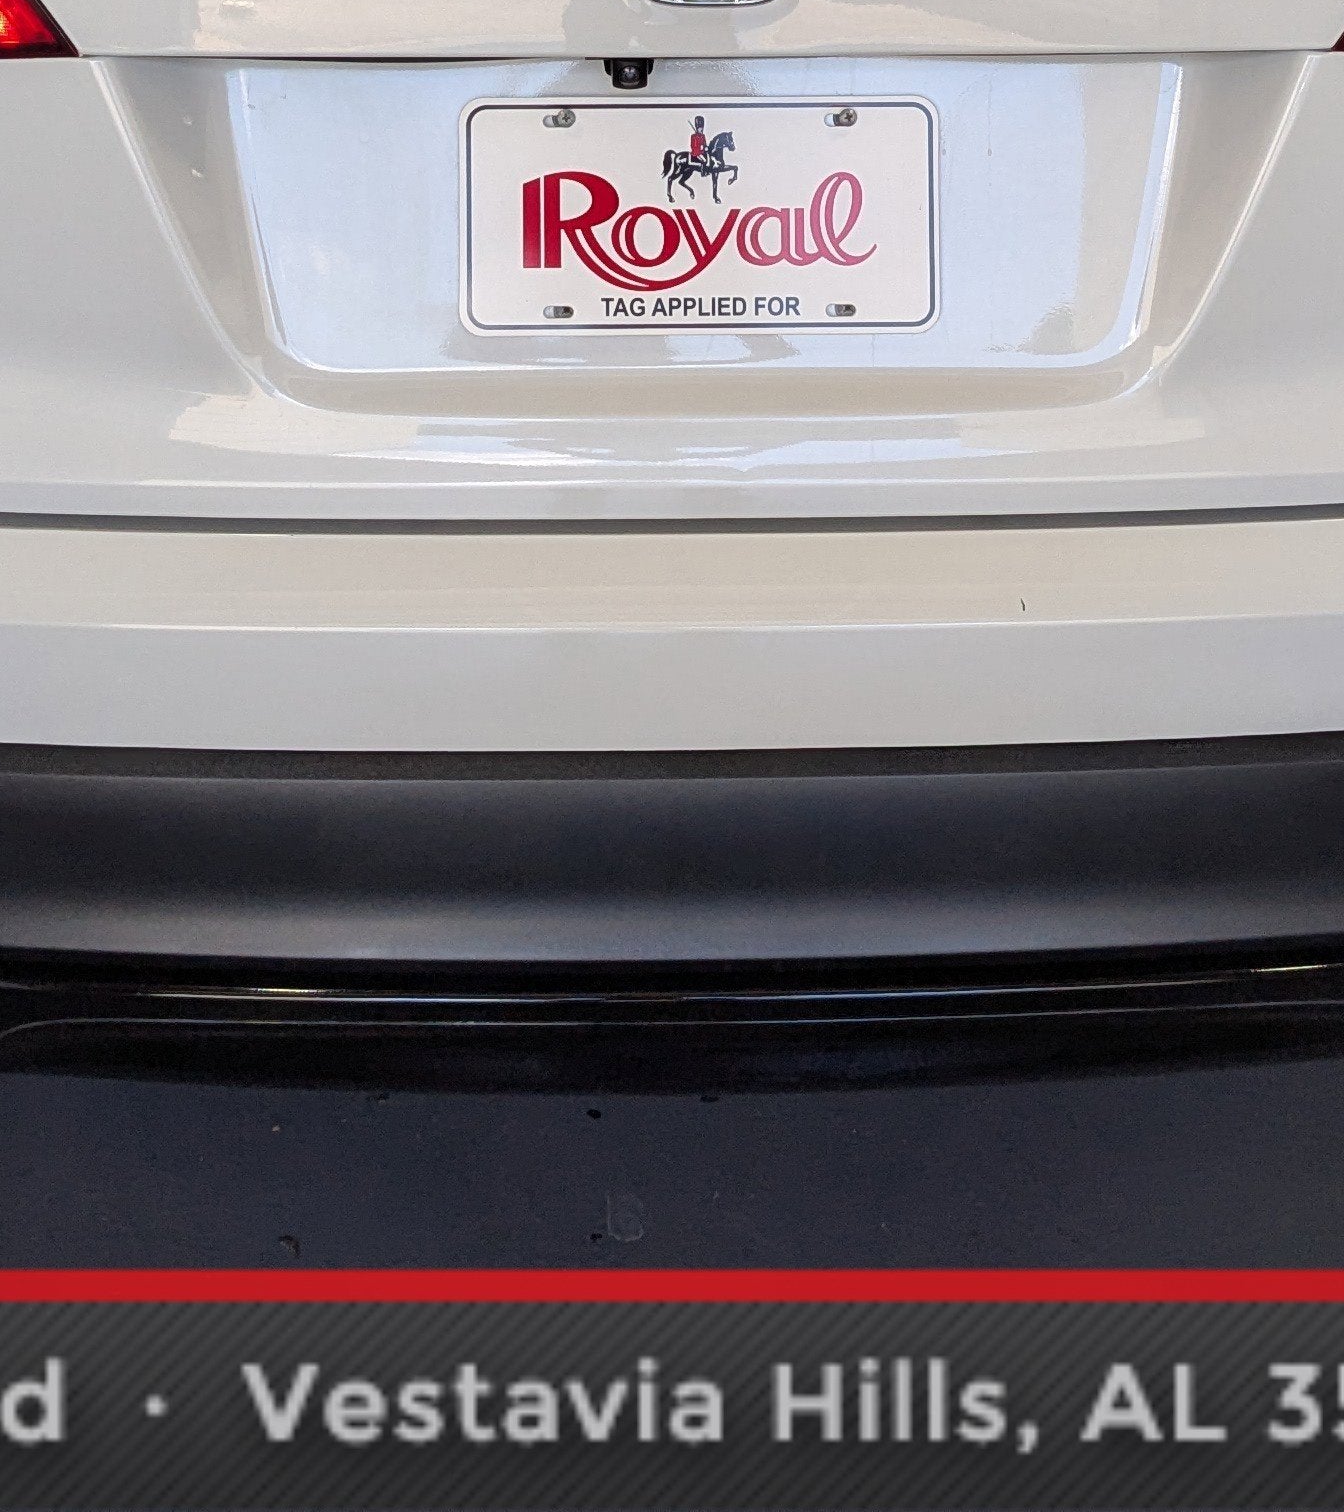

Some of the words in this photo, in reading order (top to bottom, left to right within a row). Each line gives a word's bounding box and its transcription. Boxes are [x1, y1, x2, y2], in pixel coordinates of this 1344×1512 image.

[522, 171, 877, 292] Royal
[601, 297, 646, 317] TAG
[651, 297, 747, 317] APPLIED
[754, 296, 801, 317] FOR
